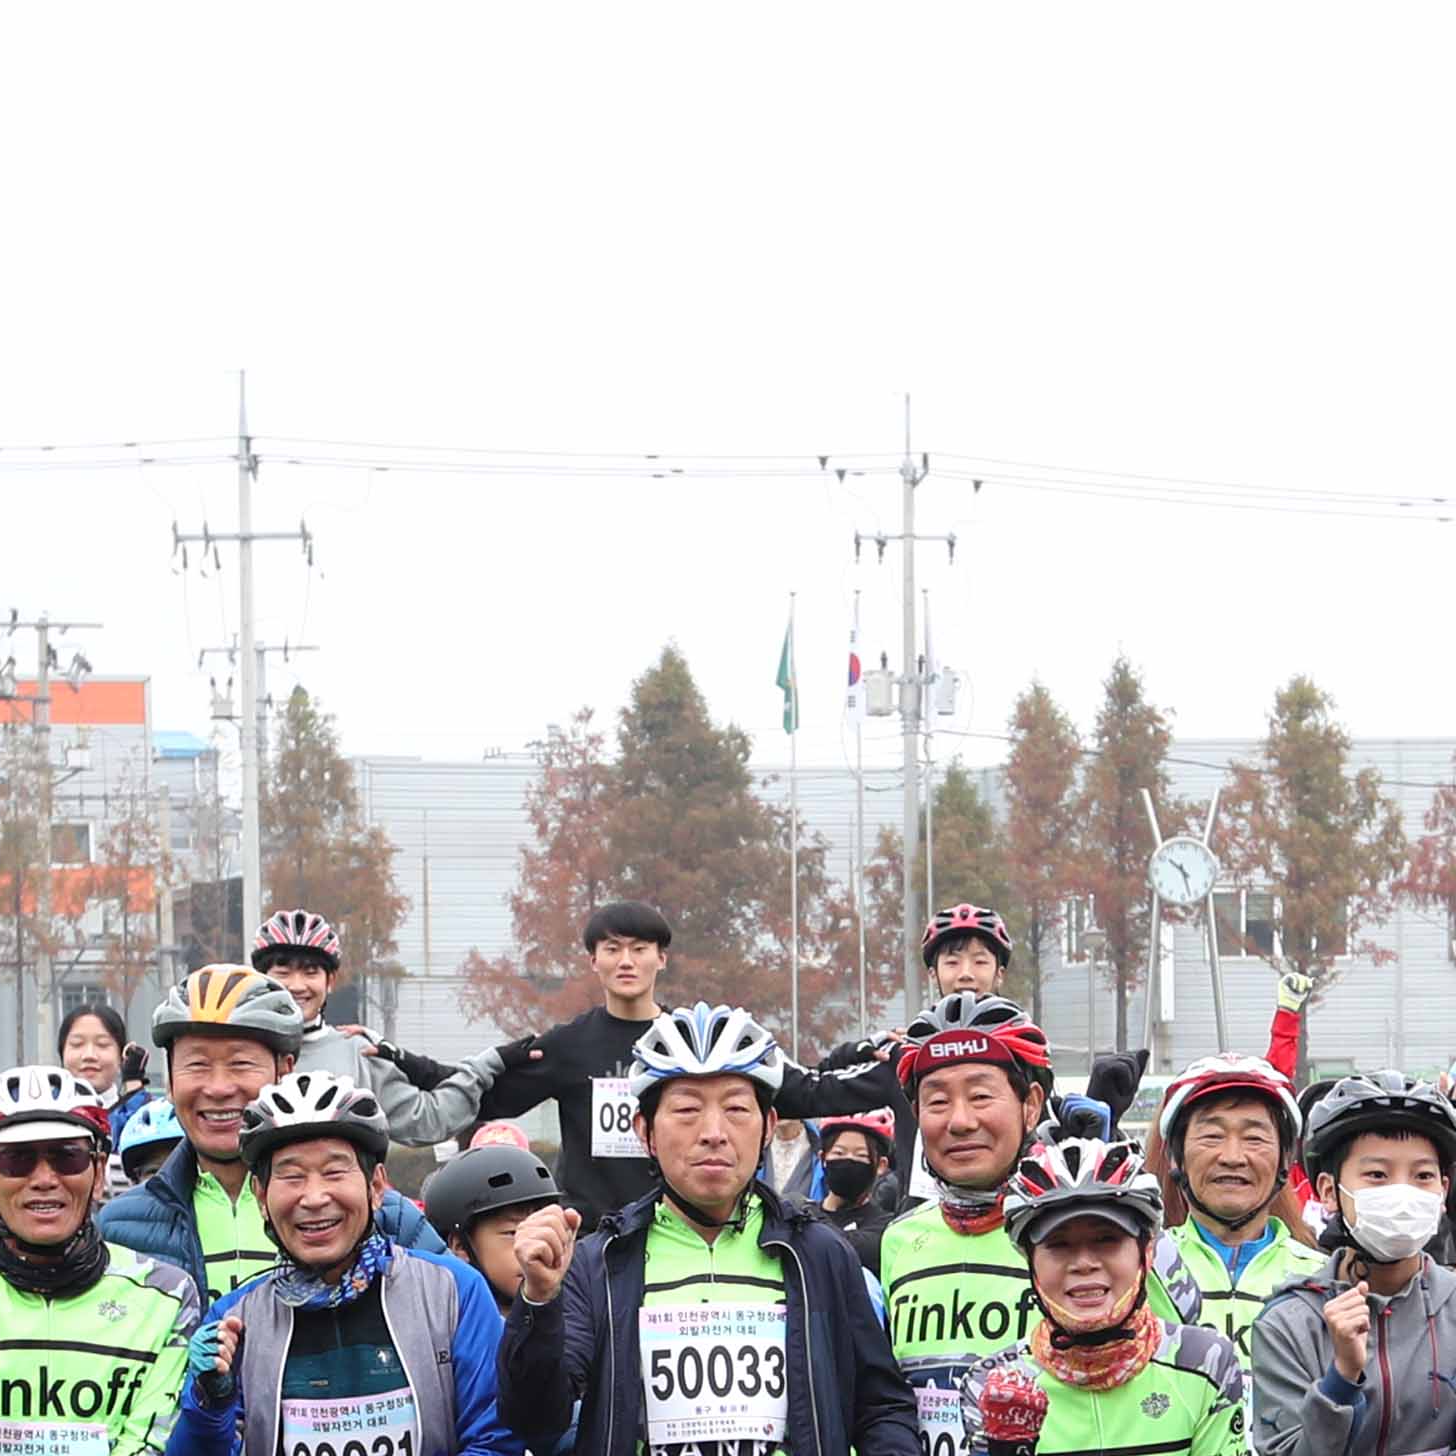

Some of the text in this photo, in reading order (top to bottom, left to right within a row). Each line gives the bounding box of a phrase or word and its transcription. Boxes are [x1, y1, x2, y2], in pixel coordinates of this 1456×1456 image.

[929, 1038, 988, 1057] BAKU
[677, 1310, 732, 1322] 인천광역시
[679, 1325, 757, 1337] 외발자전거 대회
[651, 1344, 786, 1401] 50033
[310, 1404, 362, 1419] 인천광역시
[311, 1415, 388, 1433] 외발자전거 대회
[49, 1443, 71, 1455] 대회
